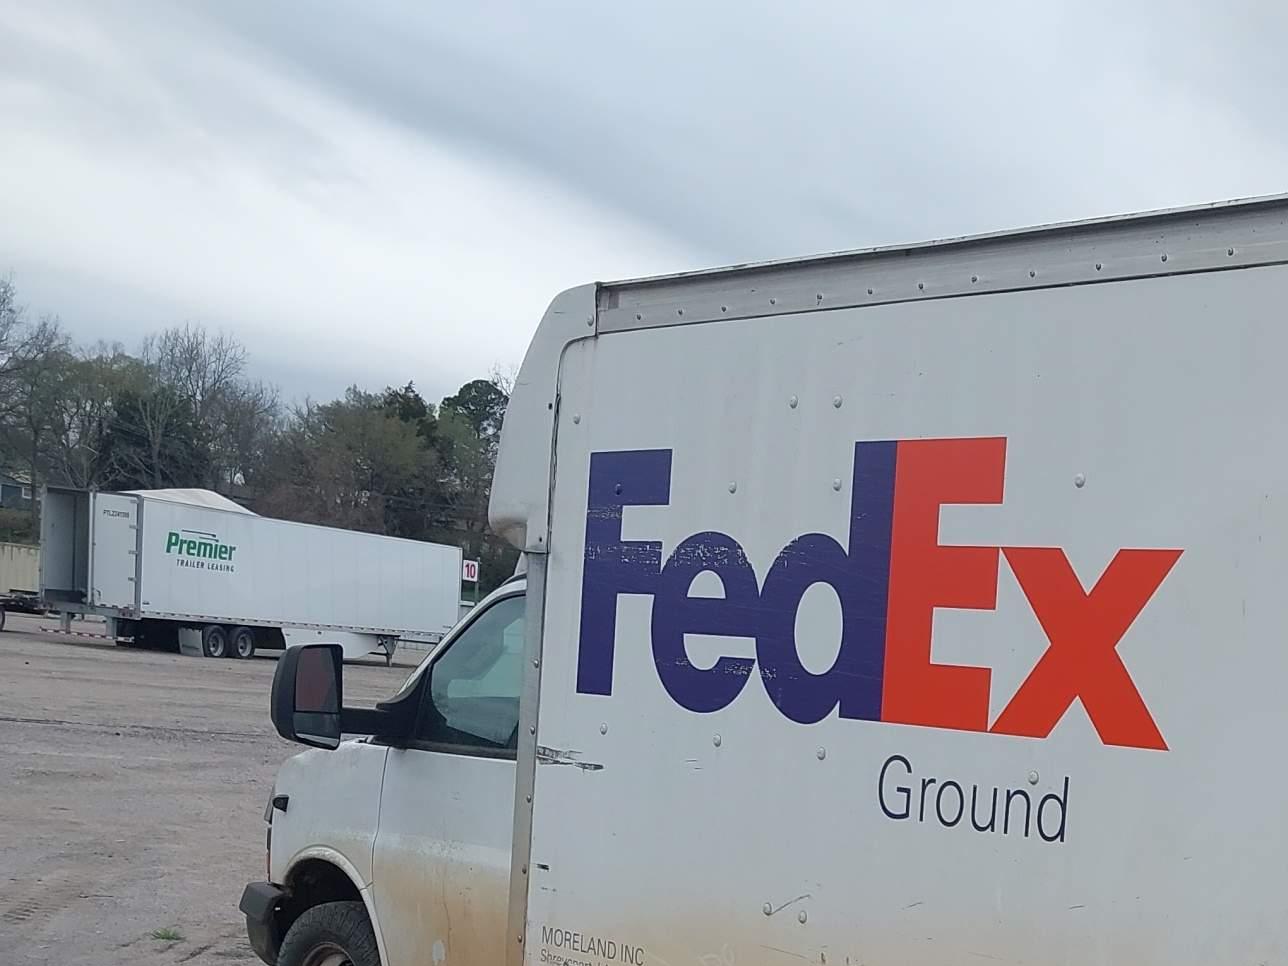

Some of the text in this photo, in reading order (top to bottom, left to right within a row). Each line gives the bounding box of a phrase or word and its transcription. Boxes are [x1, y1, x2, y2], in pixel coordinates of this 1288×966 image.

[165, 532, 237, 561] Premier
[176, 559, 235, 573] TRAILER LEASING
[465, 563, 476, 578] 10
[576, 436, 1184, 751] FedEx
[877, 754, 1071, 842] Ground
[541, 926, 645, 966] MORELAND INC
